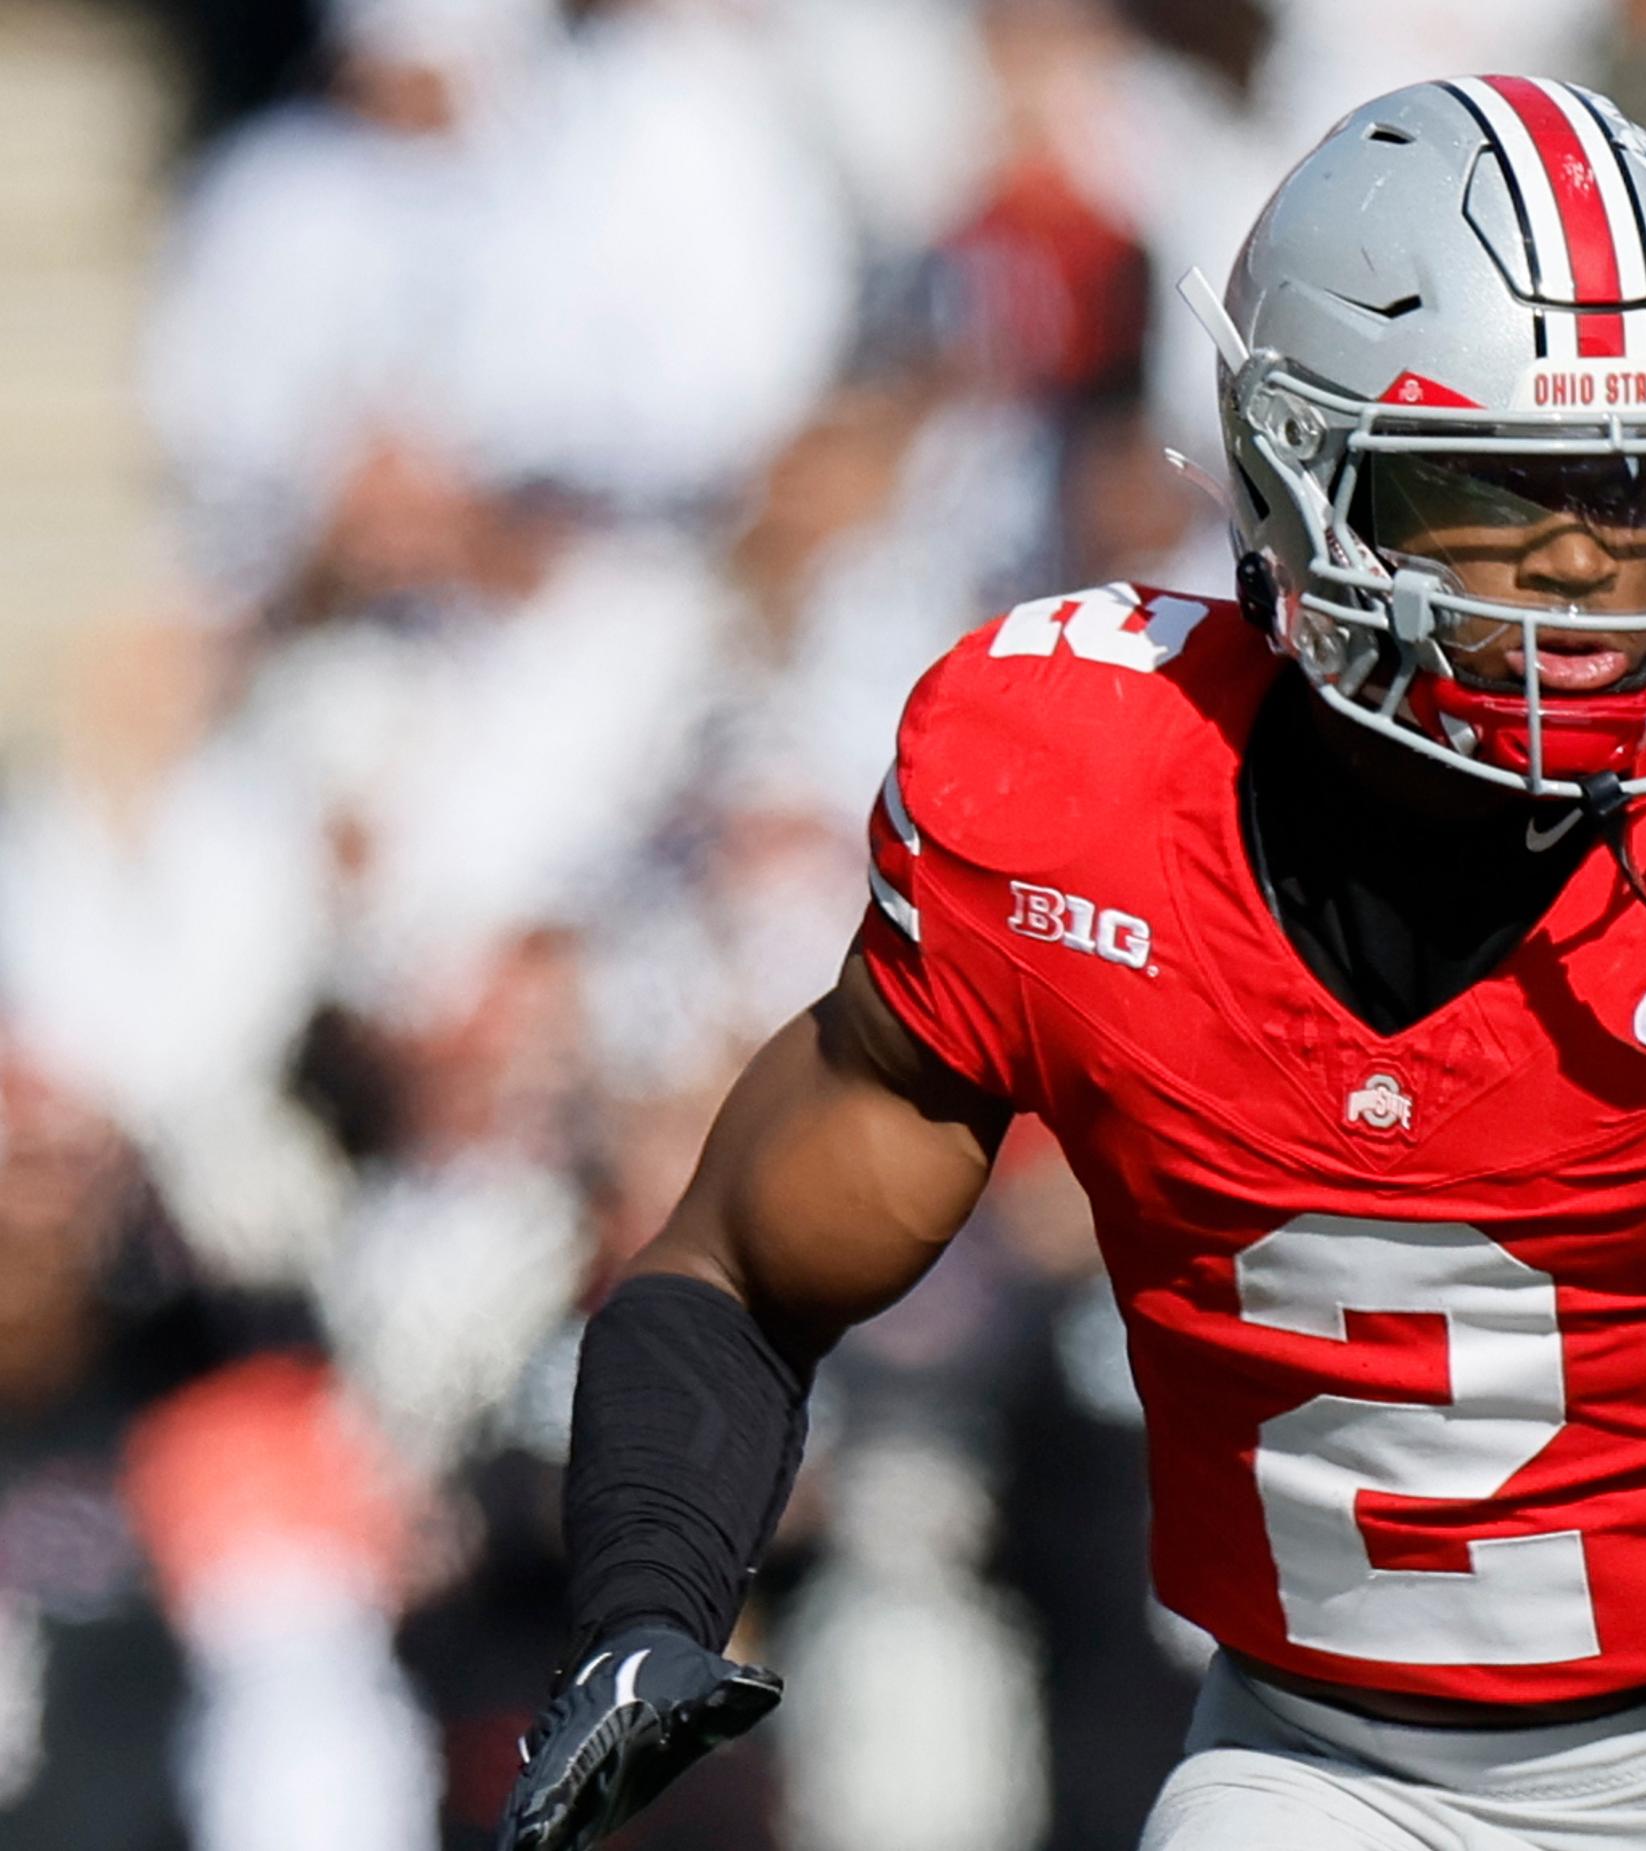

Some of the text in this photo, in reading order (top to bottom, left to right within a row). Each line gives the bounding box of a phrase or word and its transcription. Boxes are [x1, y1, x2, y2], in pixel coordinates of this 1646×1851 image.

[1535, 373, 1594, 406] OHIO
[988, 581, 1210, 673] 2
[1234, 1213, 1601, 1665] 2
